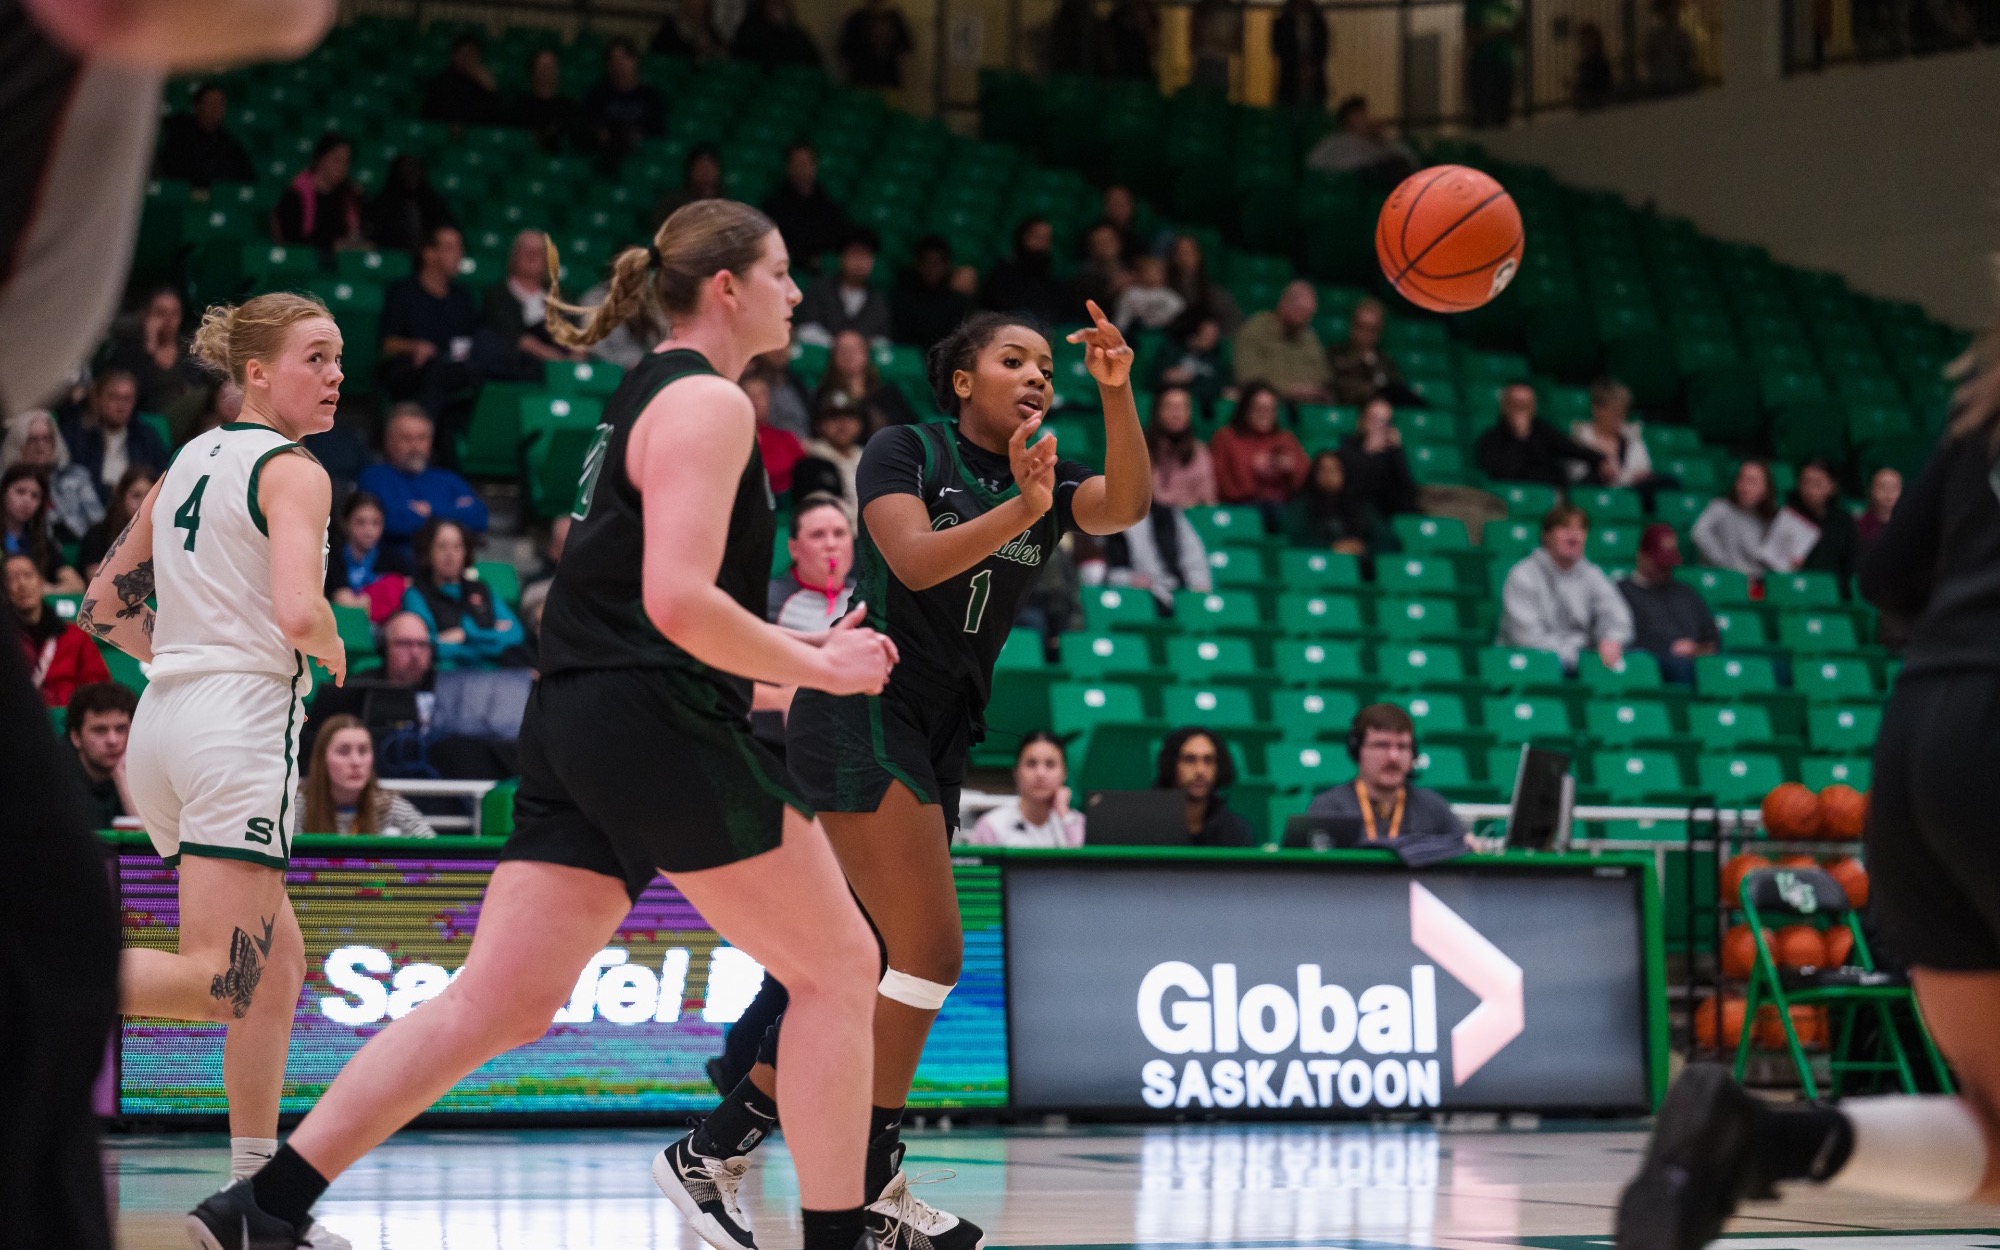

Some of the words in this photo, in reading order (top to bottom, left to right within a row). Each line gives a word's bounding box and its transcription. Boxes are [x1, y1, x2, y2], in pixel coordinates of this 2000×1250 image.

[174, 474, 210, 552] 4
[963, 569, 992, 633] 1
[244, 816, 275, 846] S
[320, 945, 690, 1025] SaTel
[1137, 961, 1437, 1054] Global
[1141, 1059, 1441, 1108] SASKATOON
